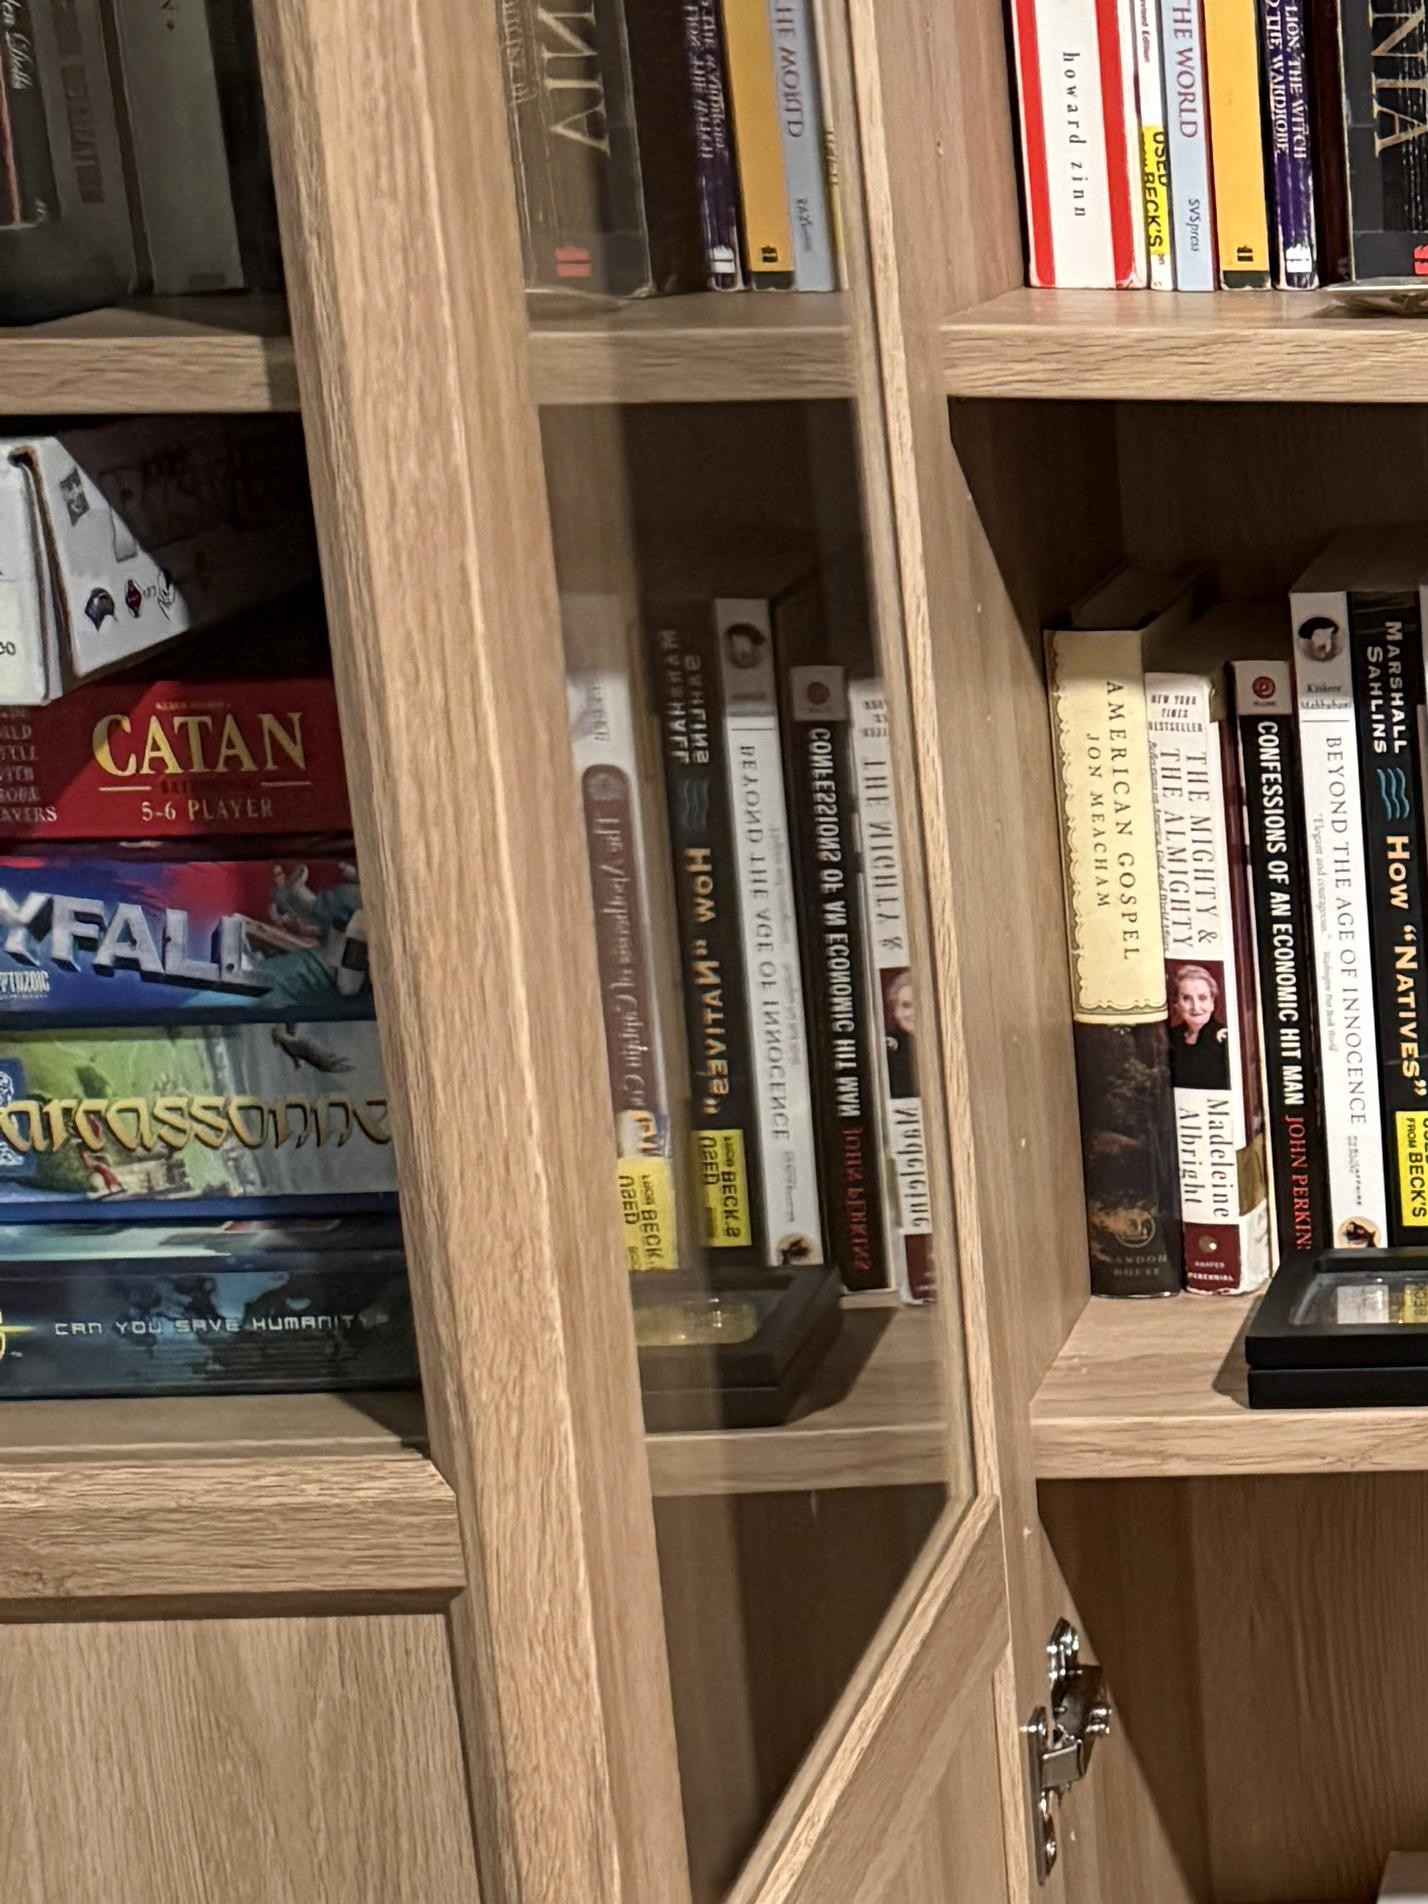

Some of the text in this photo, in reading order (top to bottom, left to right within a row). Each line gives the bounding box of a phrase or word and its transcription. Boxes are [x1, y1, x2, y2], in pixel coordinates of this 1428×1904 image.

[1063, 50, 1086, 219] howard zinn
[91, 711, 309, 780] CATAN
[1366, 647, 1388, 755] SAHLINS
[1382, 620, 1409, 755] MARSHALL
[141, 796, 275, 822] 5-6 PLAYER
[1106, 678, 1139, 962] AMERICAN GOSPEL
[1258, 720, 1305, 1106] CONFESSIONS OF AN ECONOMIC HIT MAN
